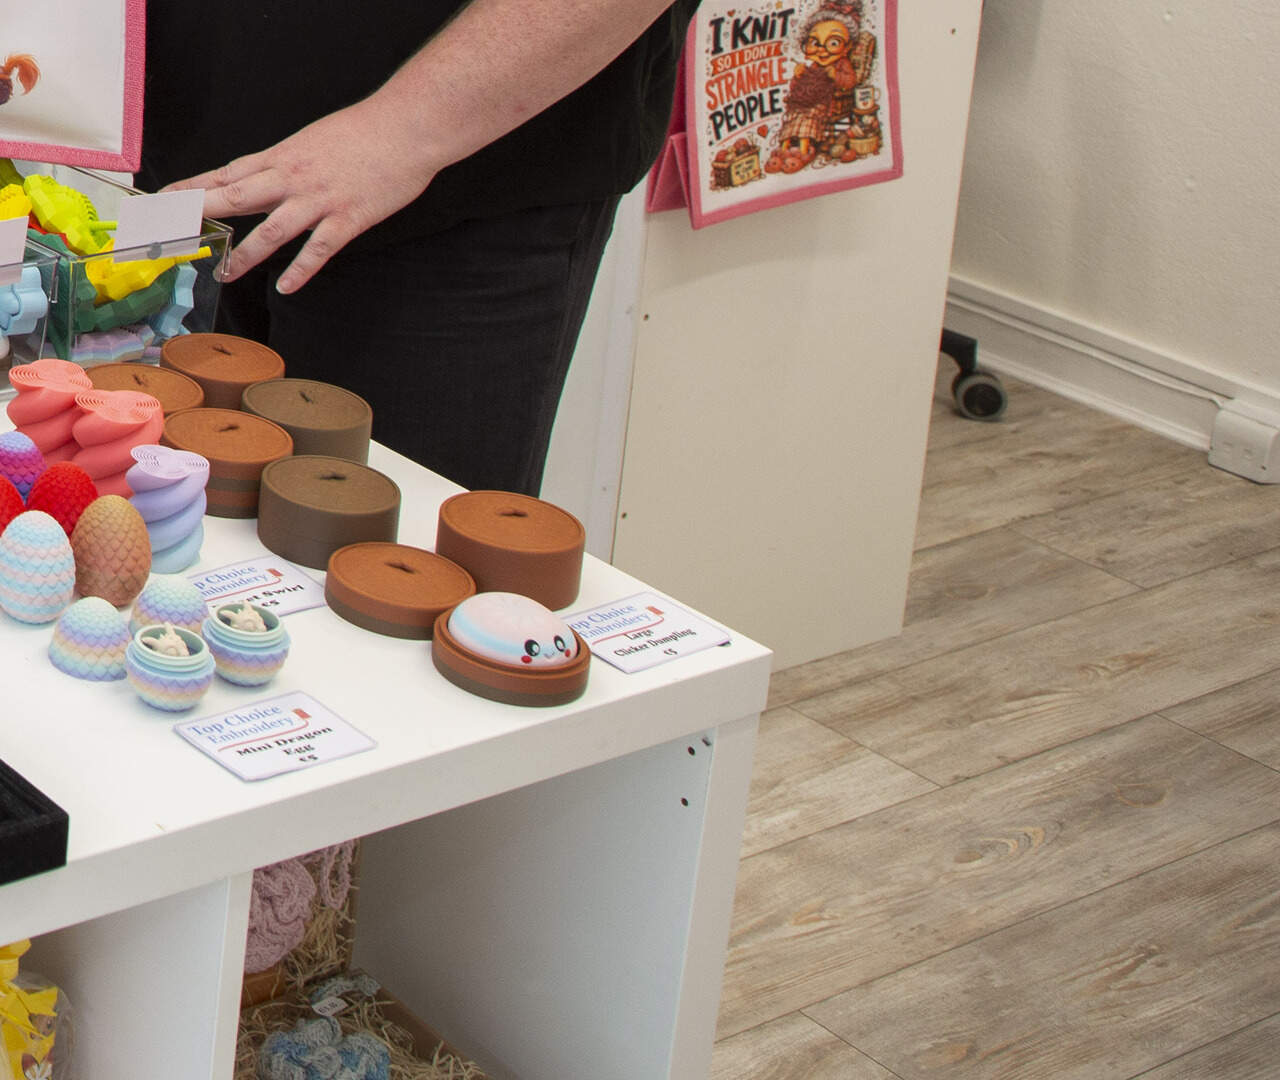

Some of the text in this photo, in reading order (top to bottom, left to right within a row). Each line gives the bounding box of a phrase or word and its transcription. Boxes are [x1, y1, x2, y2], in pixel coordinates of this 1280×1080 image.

[710, 17, 725, 55] I
[717, 56, 732, 71] SO
[705, 57, 788, 110] STRANGLE
[709, 88, 783, 140] PEOPLE
[200, 574, 269, 597] mbroidery
[205, 566, 256, 584] Choice
[262, 584, 304, 596] Swirl
[571, 605, 638, 630] op Choice
[579, 612, 651, 639] Embroidery
[614, 628, 697, 657] Clicker Dumpling
[624, 629, 654, 640] Large
[190, 705, 283, 737] Top Choice
[208, 715, 294, 744] Embroidery
[235, 726, 333, 757] Mini Dragon
[283, 744, 315, 757] Egg
